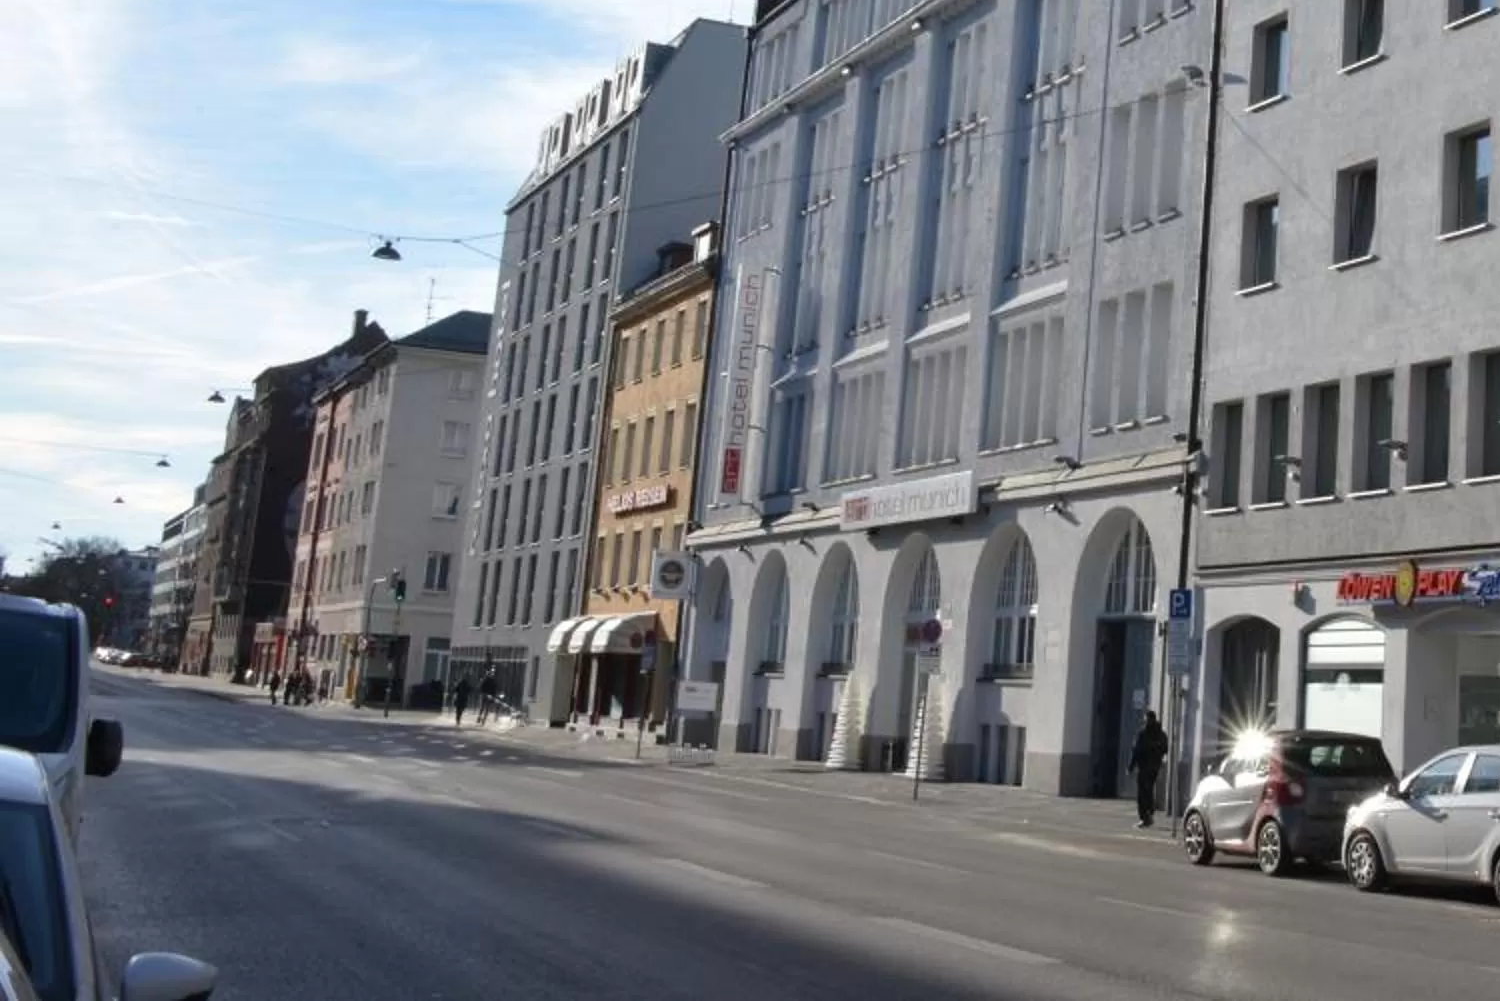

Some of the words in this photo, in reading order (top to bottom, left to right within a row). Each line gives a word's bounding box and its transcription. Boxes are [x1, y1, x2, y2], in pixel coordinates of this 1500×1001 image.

[738, 274, 760, 371] munich
[1337, 572, 1395, 600] LÖWEN
[1417, 570, 1464, 597] PLAY
